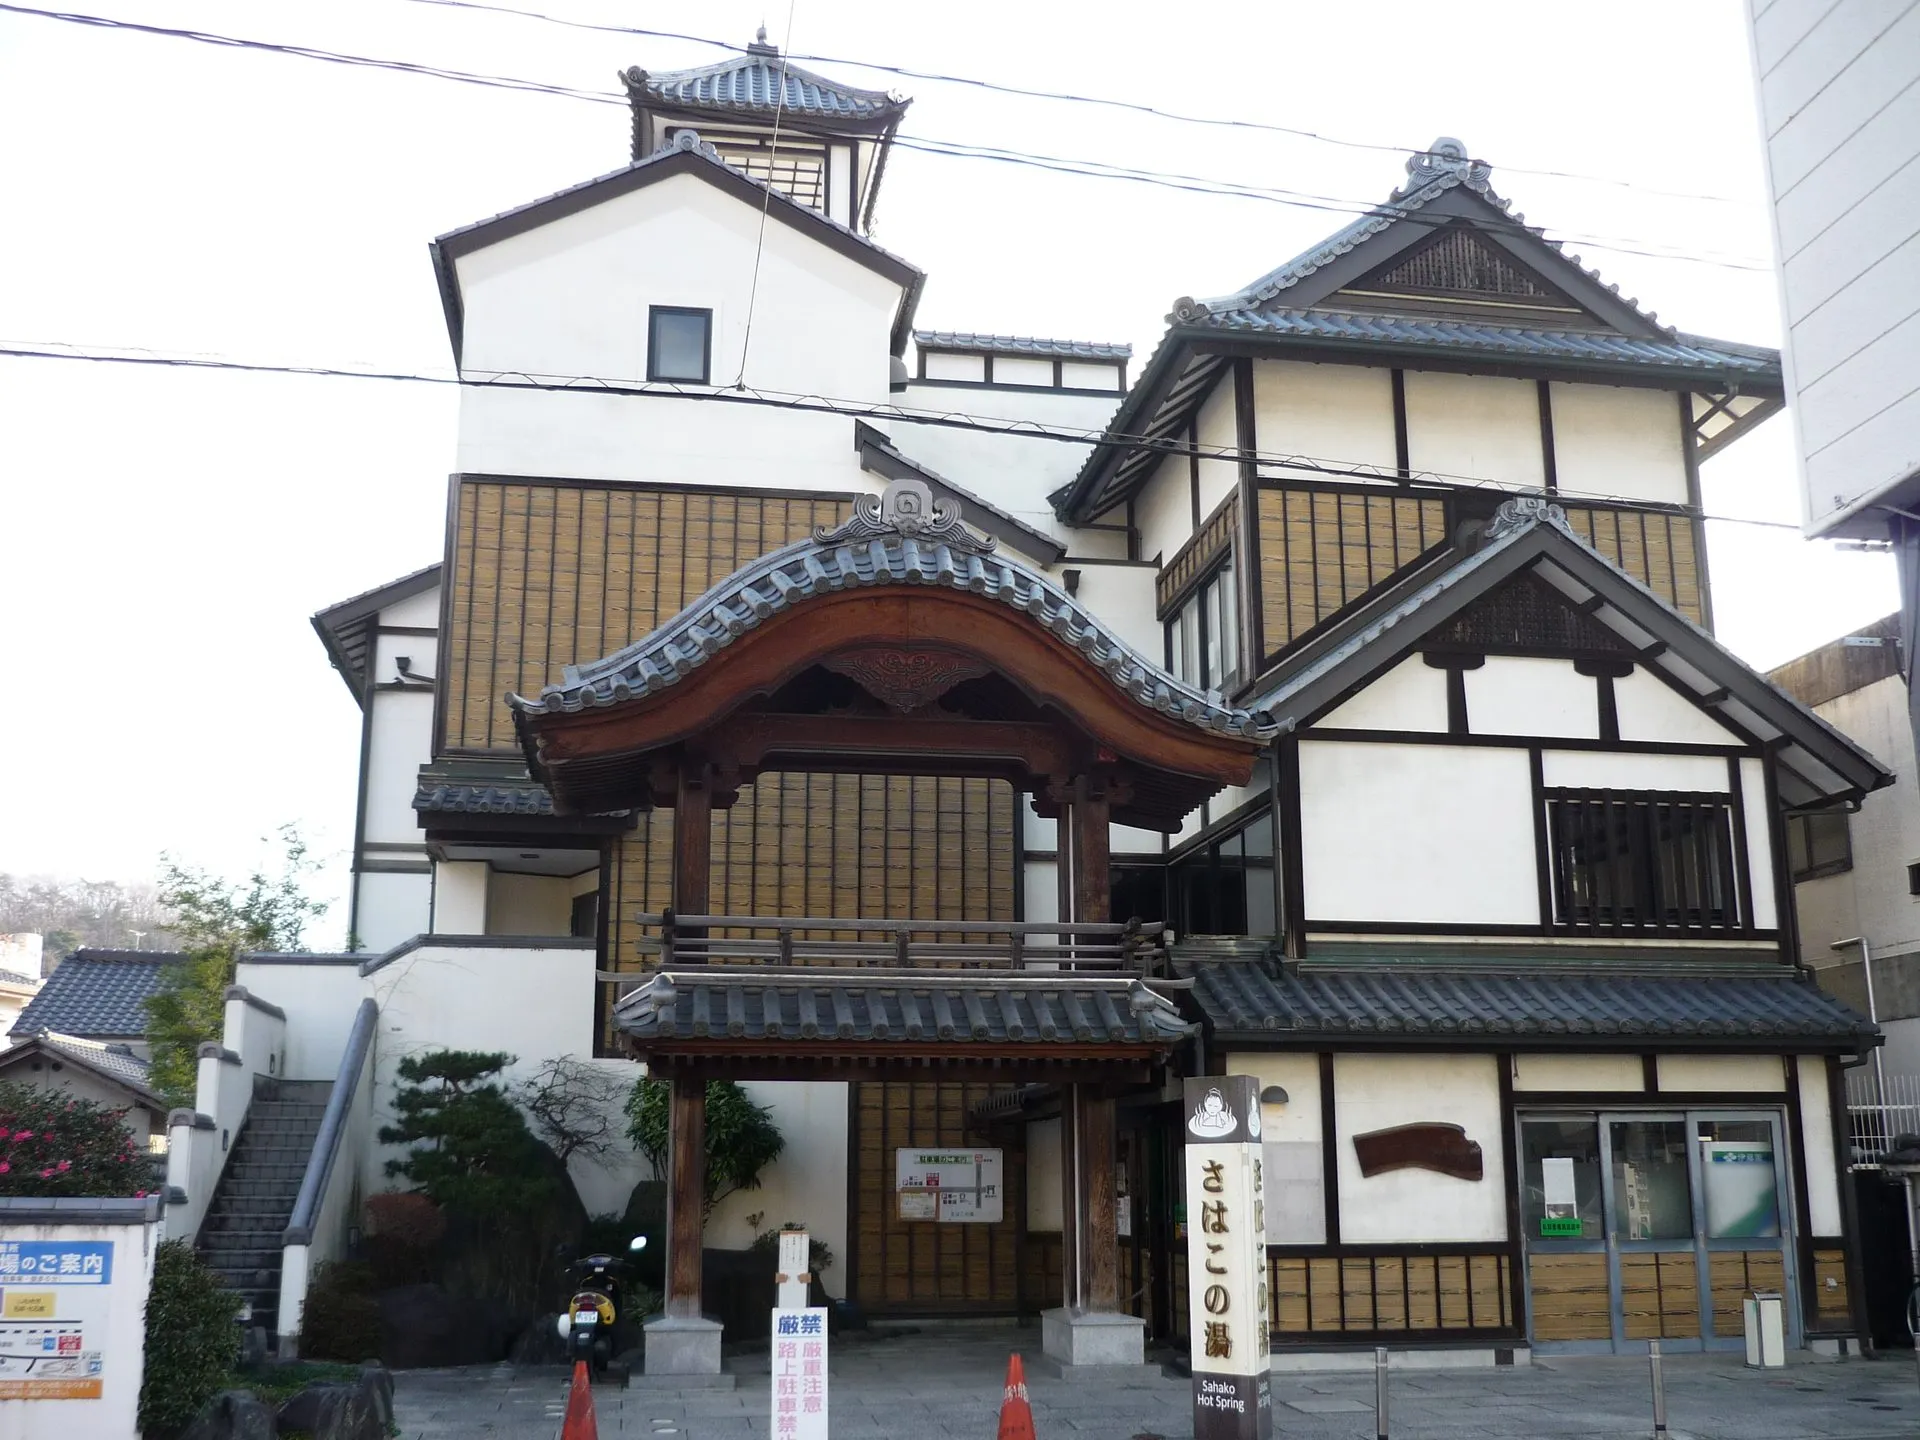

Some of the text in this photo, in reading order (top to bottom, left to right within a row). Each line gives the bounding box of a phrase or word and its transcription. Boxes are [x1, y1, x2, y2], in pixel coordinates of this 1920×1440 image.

[0, 1253, 104, 1274] 場のご案内
[1201, 1159, 1233, 1360] さはこの湯
[778, 1314, 822, 1334] 厳禁
[803, 1342, 822, 1413] 厳重注意
[1202, 1380, 1236, 1395] Sahako
[1197, 1393, 1214, 1407] Hot
[1215, 1396, 1245, 1413] Spring
